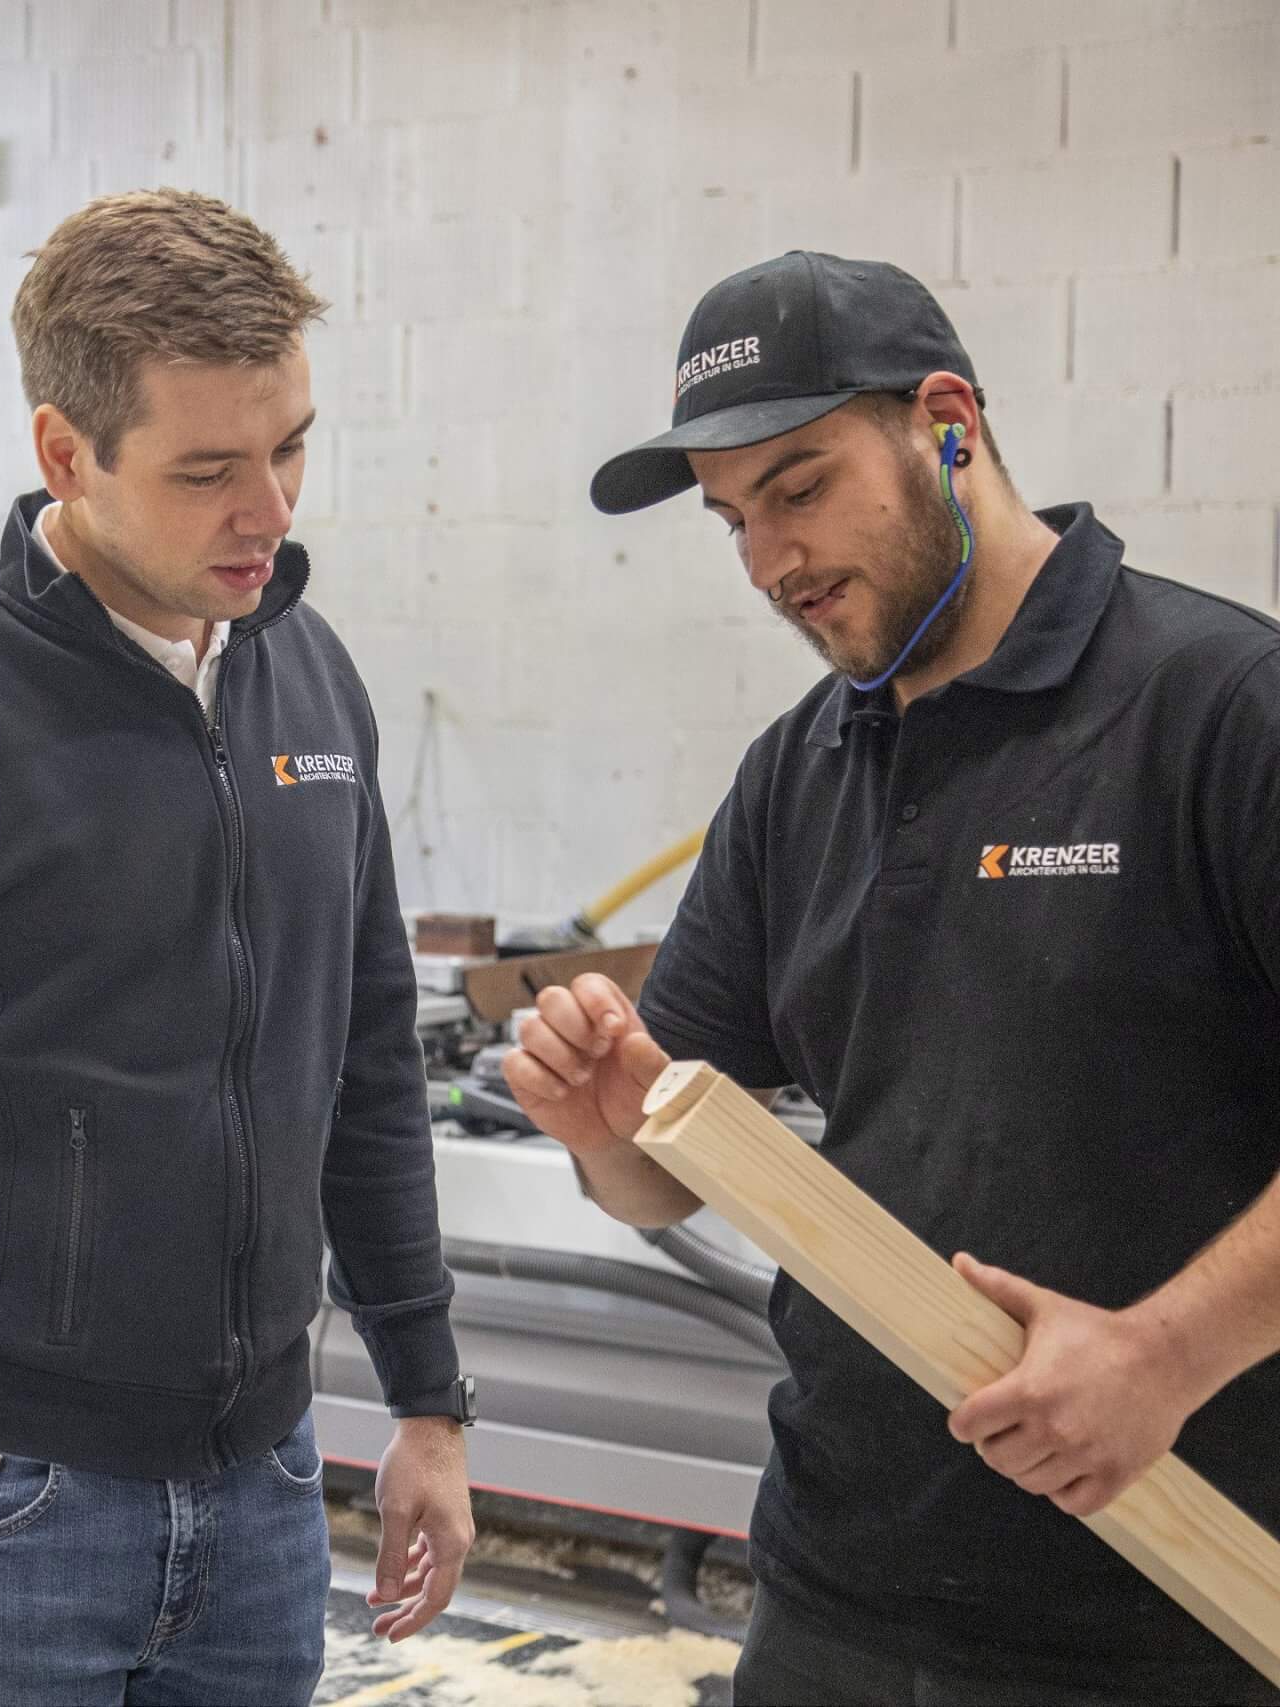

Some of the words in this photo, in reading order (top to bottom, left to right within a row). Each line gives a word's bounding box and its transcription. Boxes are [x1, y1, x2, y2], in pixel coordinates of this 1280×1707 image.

[721, 362, 732, 373] IN
[733, 354, 761, 369] GLAS
[294, 753, 355, 775] KRENZER
[1010, 843, 1120, 867] KRENZER
[1007, 864, 1077, 877] ARCHITEKTUR
[1078, 864, 1089, 875] IN
[1089, 863, 1120, 875] GLAS
